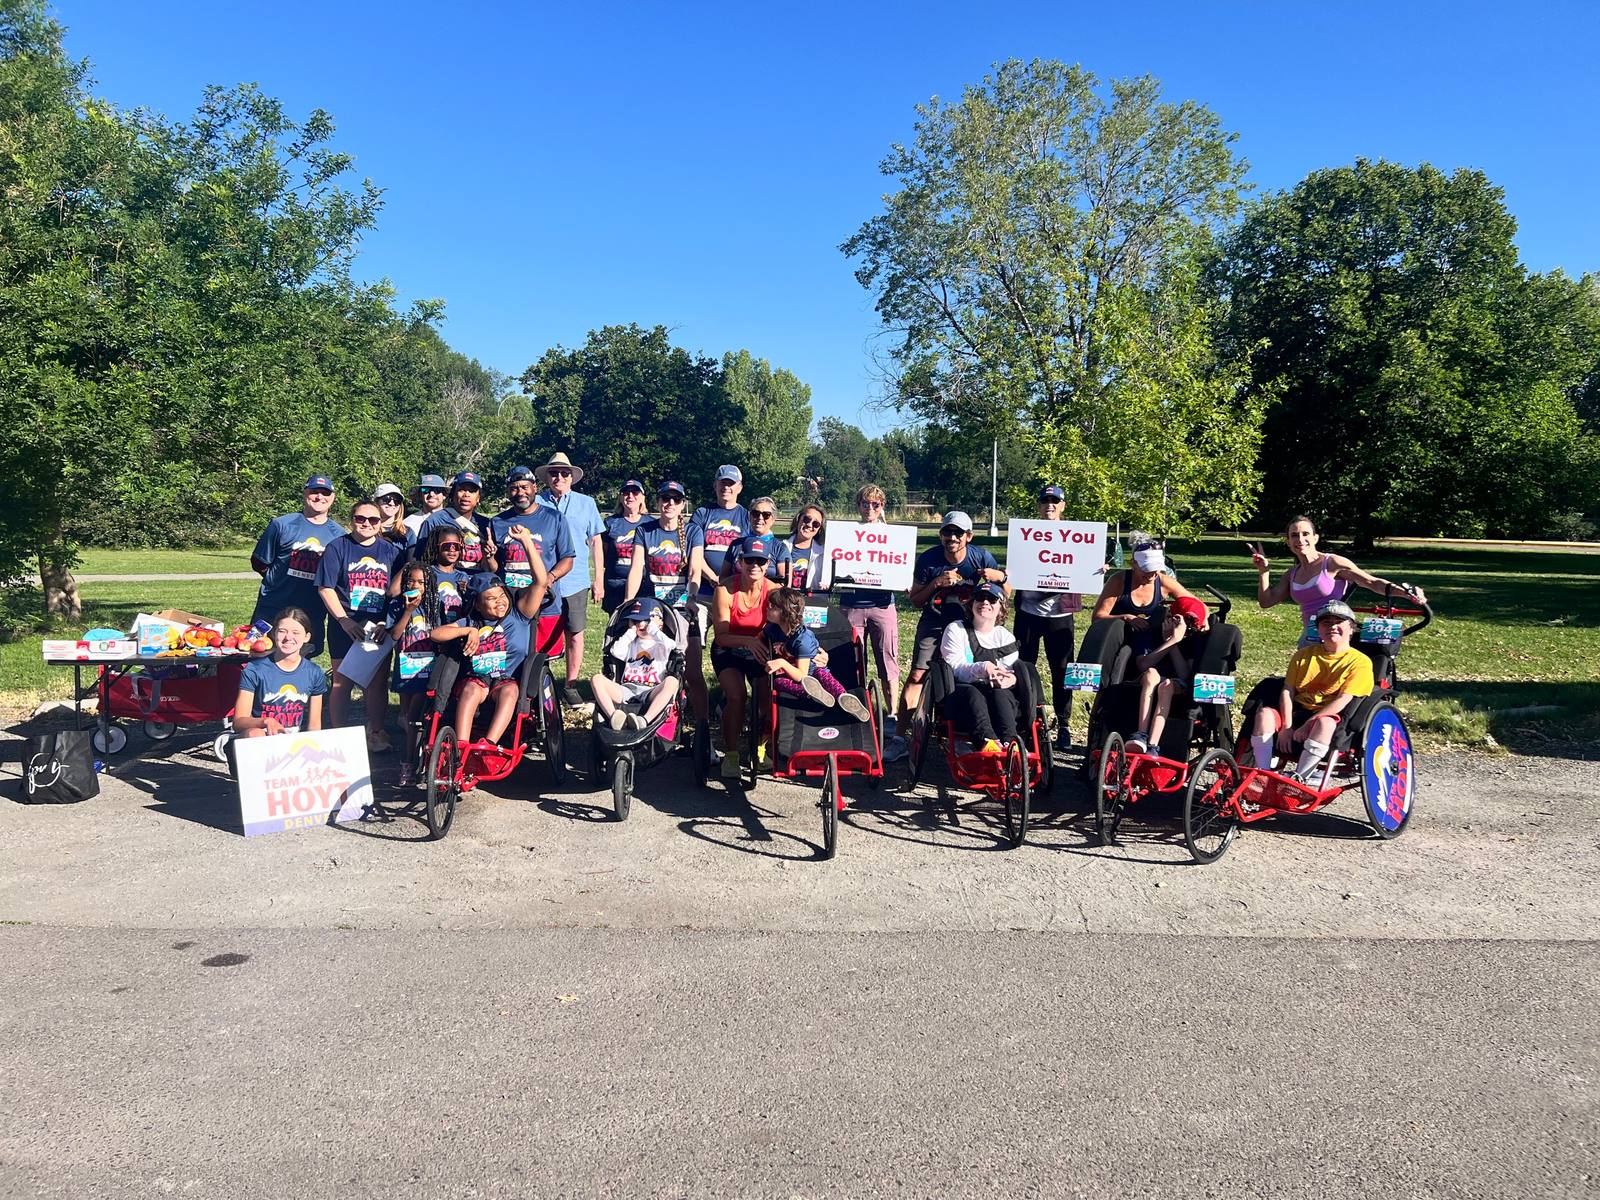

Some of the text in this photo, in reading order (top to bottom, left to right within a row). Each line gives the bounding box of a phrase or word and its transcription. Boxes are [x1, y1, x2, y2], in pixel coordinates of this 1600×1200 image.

[855, 530, 887, 544] You
[1020, 527, 1095, 544] Yes You
[831, 548, 907, 565] Got This!
[1038, 549, 1073, 565] Can
[1367, 623, 1393, 633] 104
[1071, 669, 1094, 680] 100
[1200, 681, 1227, 691] 100
[261, 704, 282, 713] TEAM
[263, 775, 300, 790] TEAM
[266, 781, 351, 816] HOYT
